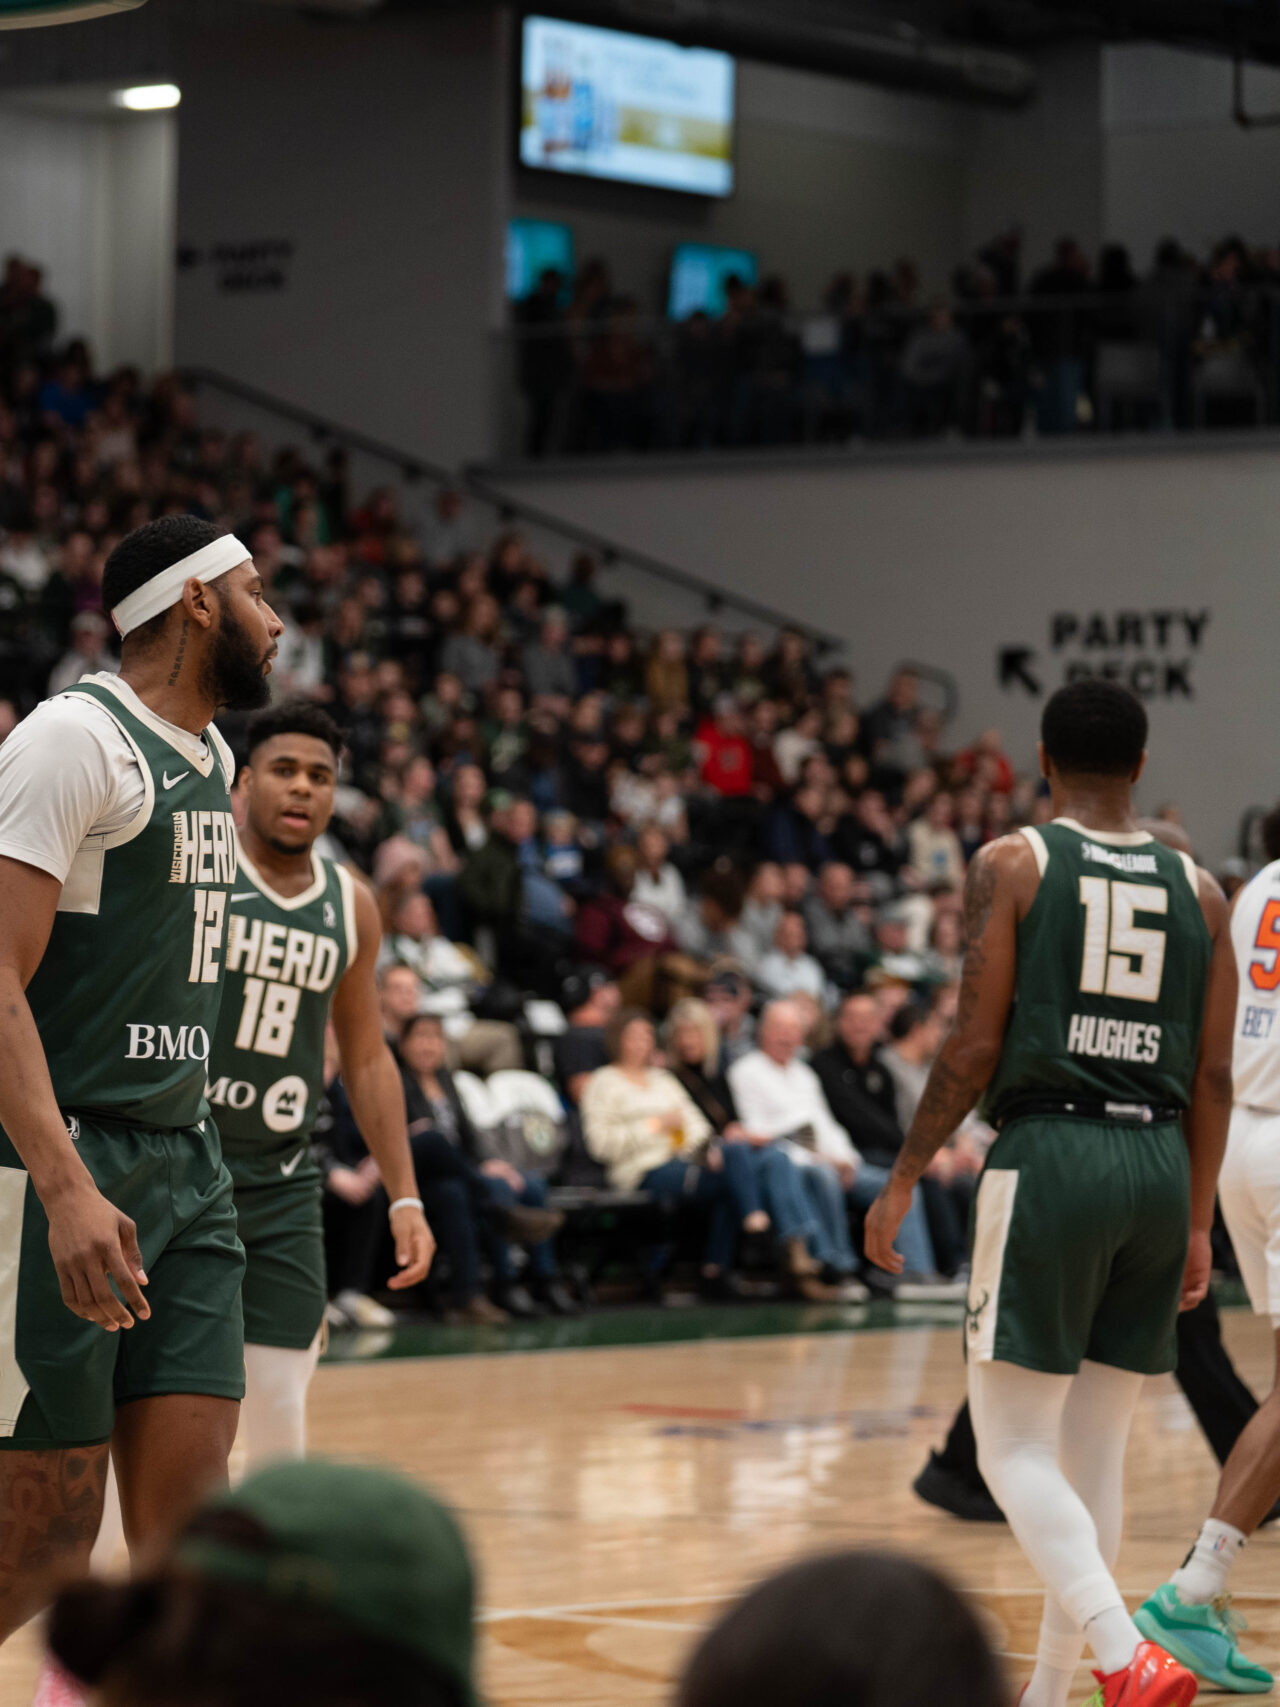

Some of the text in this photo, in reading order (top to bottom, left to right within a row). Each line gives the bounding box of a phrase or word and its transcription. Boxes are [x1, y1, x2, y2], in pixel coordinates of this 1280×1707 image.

[1051, 608, 1209, 649] PARTY
[168, 811, 183, 883] WISCONSIN
[182, 811, 238, 884] HERD
[188, 888, 227, 983] 12
[231, 914, 340, 993] HERD
[1079, 875, 1168, 1003] 15
[125, 1024, 210, 1060] BMO
[235, 977, 301, 1058] 18
[1068, 1014, 1162, 1064] HUGHES
[204, 1076, 257, 1110] MO
